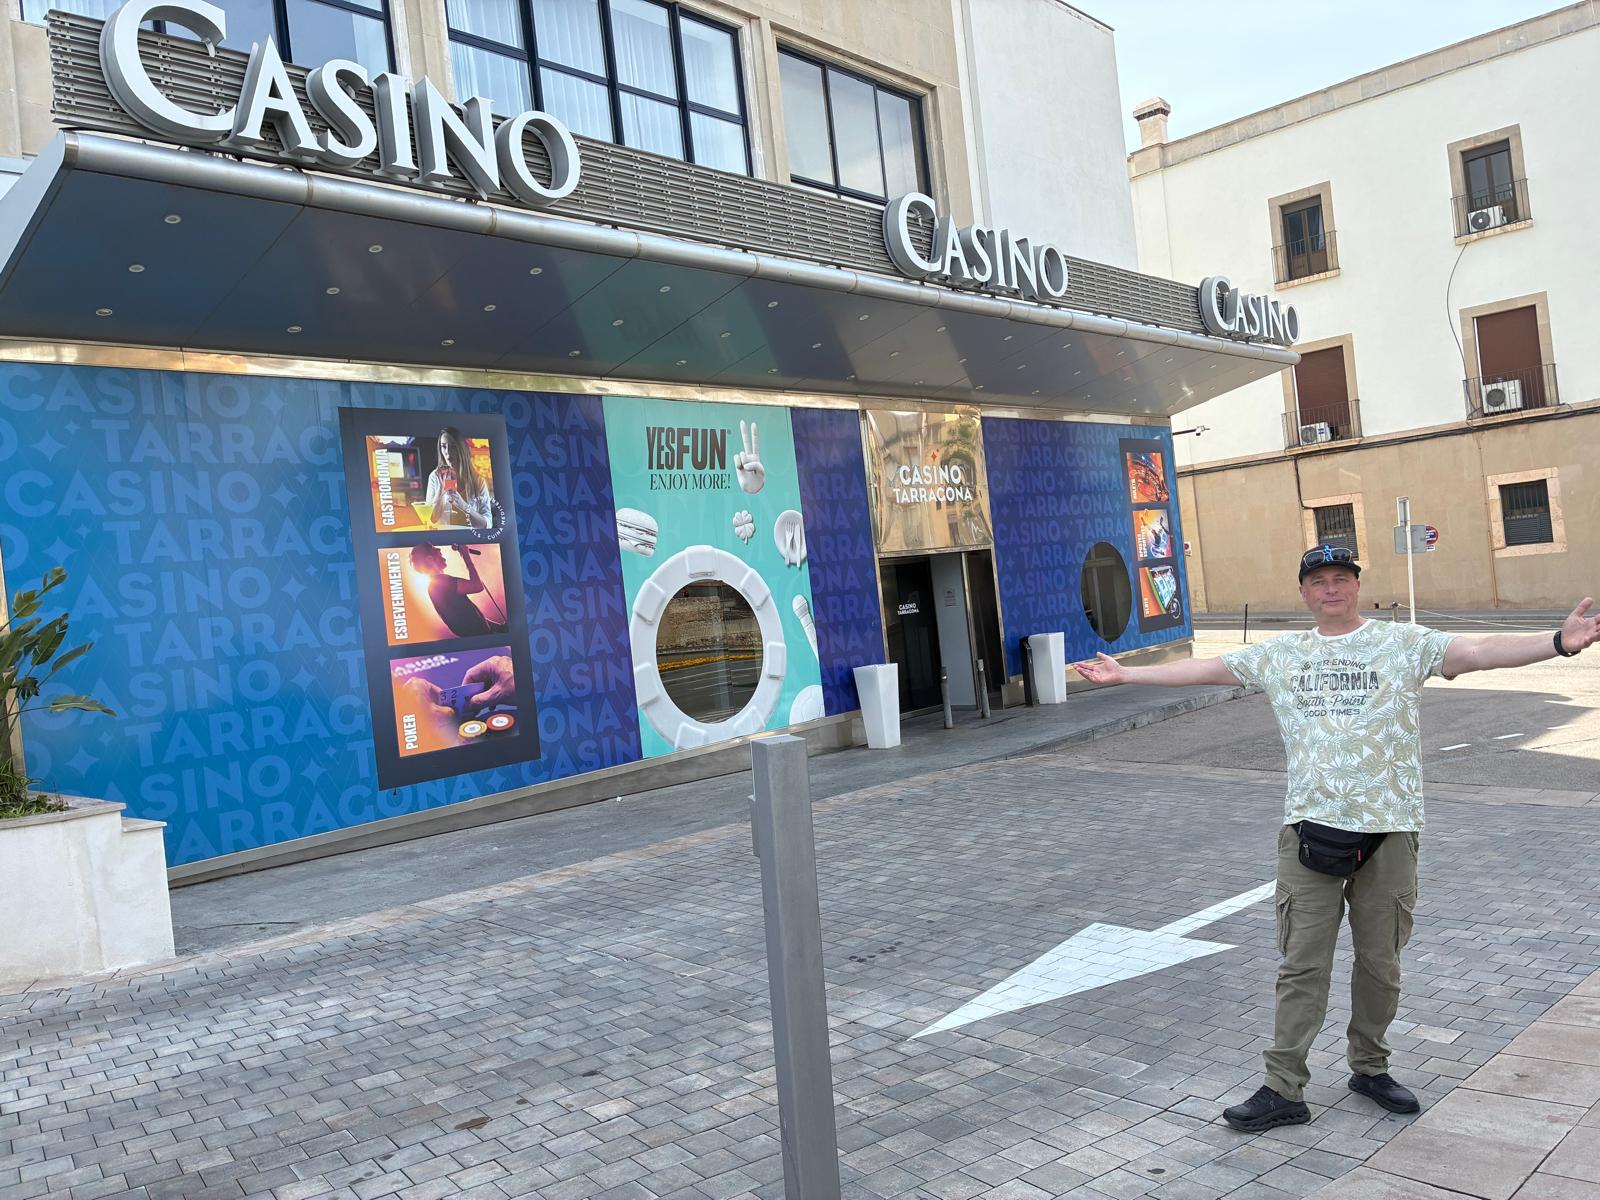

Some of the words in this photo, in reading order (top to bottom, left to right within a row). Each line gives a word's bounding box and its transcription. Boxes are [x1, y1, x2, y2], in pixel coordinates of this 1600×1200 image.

[100, 0, 582, 206] CASINO
[883, 191, 1070, 300] CASINO
[1200, 276, 1300, 346] CASINO
[3, 364, 251, 418] CASINO
[91, 418, 341, 464] TARRAG
[508, 433, 607, 468] ASIN
[646, 426, 727, 471] YESFUN
[1012, 446, 1108, 467] TARRAGONA
[375, 448, 396, 526] GASTRONOMIA
[650, 473, 690, 490] ENJOY
[692, 473, 731, 490] MORE!
[900, 464, 961, 485] CASINO
[990, 470, 1056, 494] CASINO
[1070, 469, 1123, 492] TARRA
[4, 470, 262, 517] CASINO
[893, 486, 972, 503] TARRAGONA
[1018, 494, 1114, 517] TARRAGONA
[103, 515, 353, 566] TARRAG
[516, 510, 615, 545] ASIN
[995, 520, 1061, 545] CASINO
[1076, 517, 1129, 540] TARRA
[387, 552, 409, 640] ESDEVENIMENTS
[1001, 570, 1066, 598] CASINO
[898, 602, 917, 610] CASINO
[1025, 592, 1081, 619] TARRA
[114, 606, 360, 667] TARRAG
[525, 585, 624, 625] ASIN
[1290, 671, 1379, 694] CALIFORNIA
[1330, 693, 1372, 707] Point
[124, 694, 369, 768] TARRAG
[533, 657, 632, 704] ASIN
[1304, 709, 1327, 718] GOOD
[1330, 708, 1361, 716] TIMES
[402, 713, 419, 750] POKER
[166, 772, 484, 864] ARRAGONA
